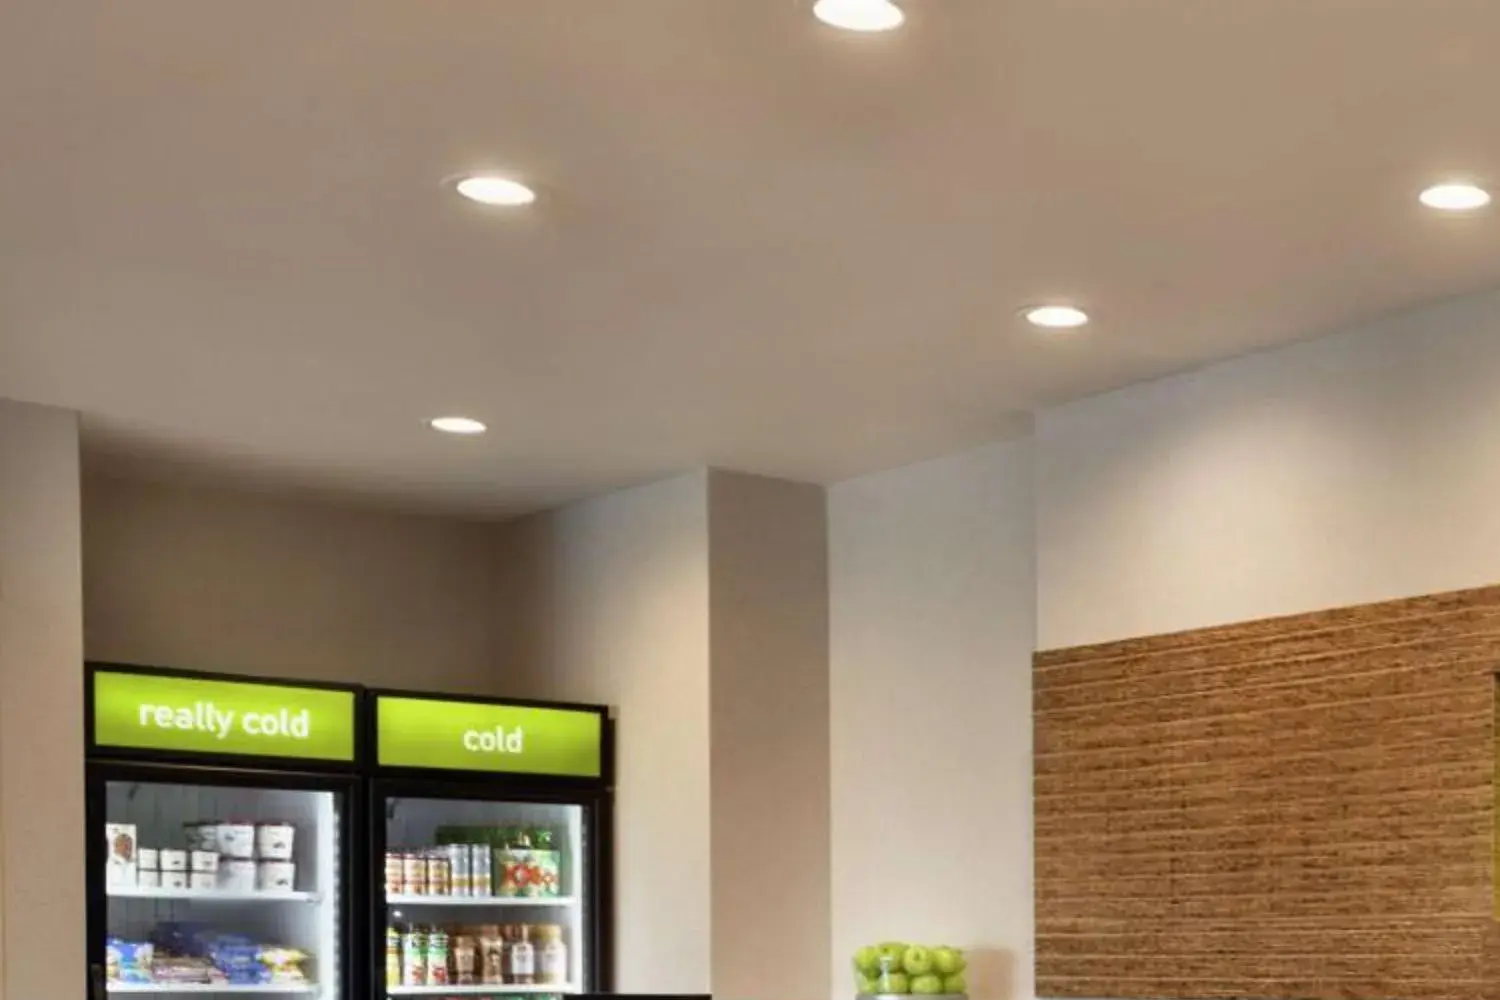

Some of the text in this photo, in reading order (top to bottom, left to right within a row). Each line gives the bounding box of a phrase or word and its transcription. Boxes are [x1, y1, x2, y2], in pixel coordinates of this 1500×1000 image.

[139, 700, 309, 739] really cold
[463, 725, 522, 753] cold
